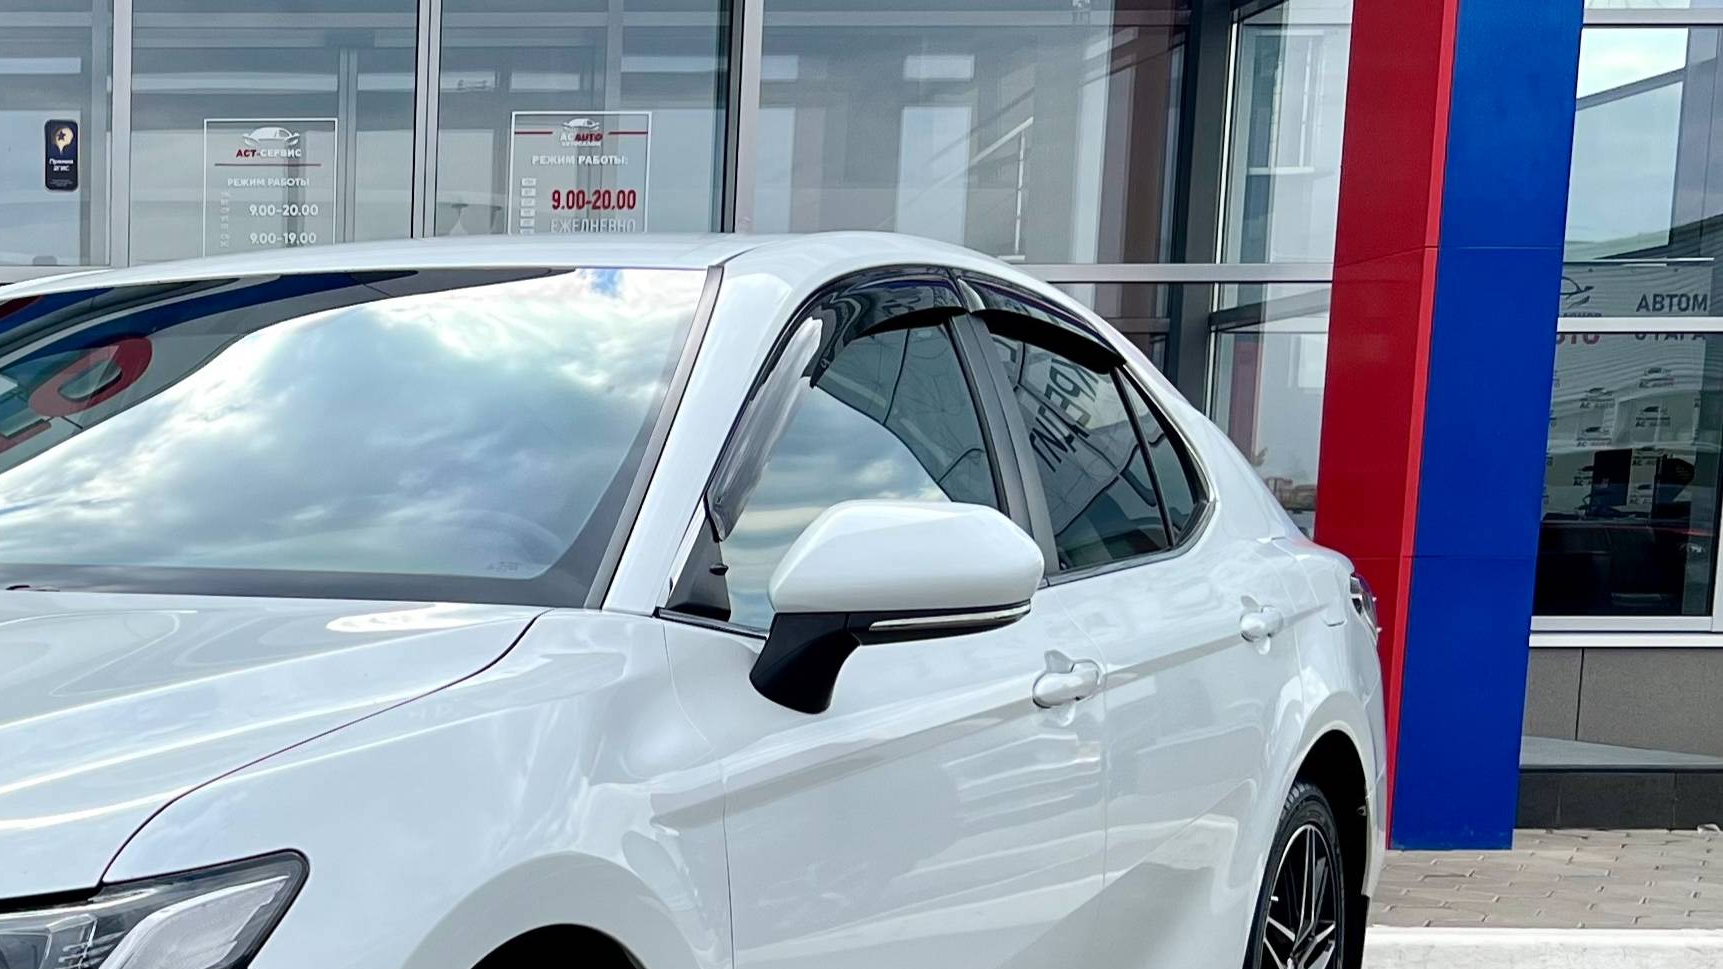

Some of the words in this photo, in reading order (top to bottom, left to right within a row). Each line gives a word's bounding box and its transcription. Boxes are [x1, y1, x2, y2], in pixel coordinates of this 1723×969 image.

[575, 133, 604, 142] AUTO
[236, 149, 302, 158] АСТ-СЕРВИС
[532, 155, 575, 165] РЕЖИМ
[228, 178, 265, 186] РЕЖИМ
[552, 190, 636, 210] 9.00-20.00
[249, 204, 318, 216] 9.00-20.00
[250, 232, 317, 244] 9.00-19.00
